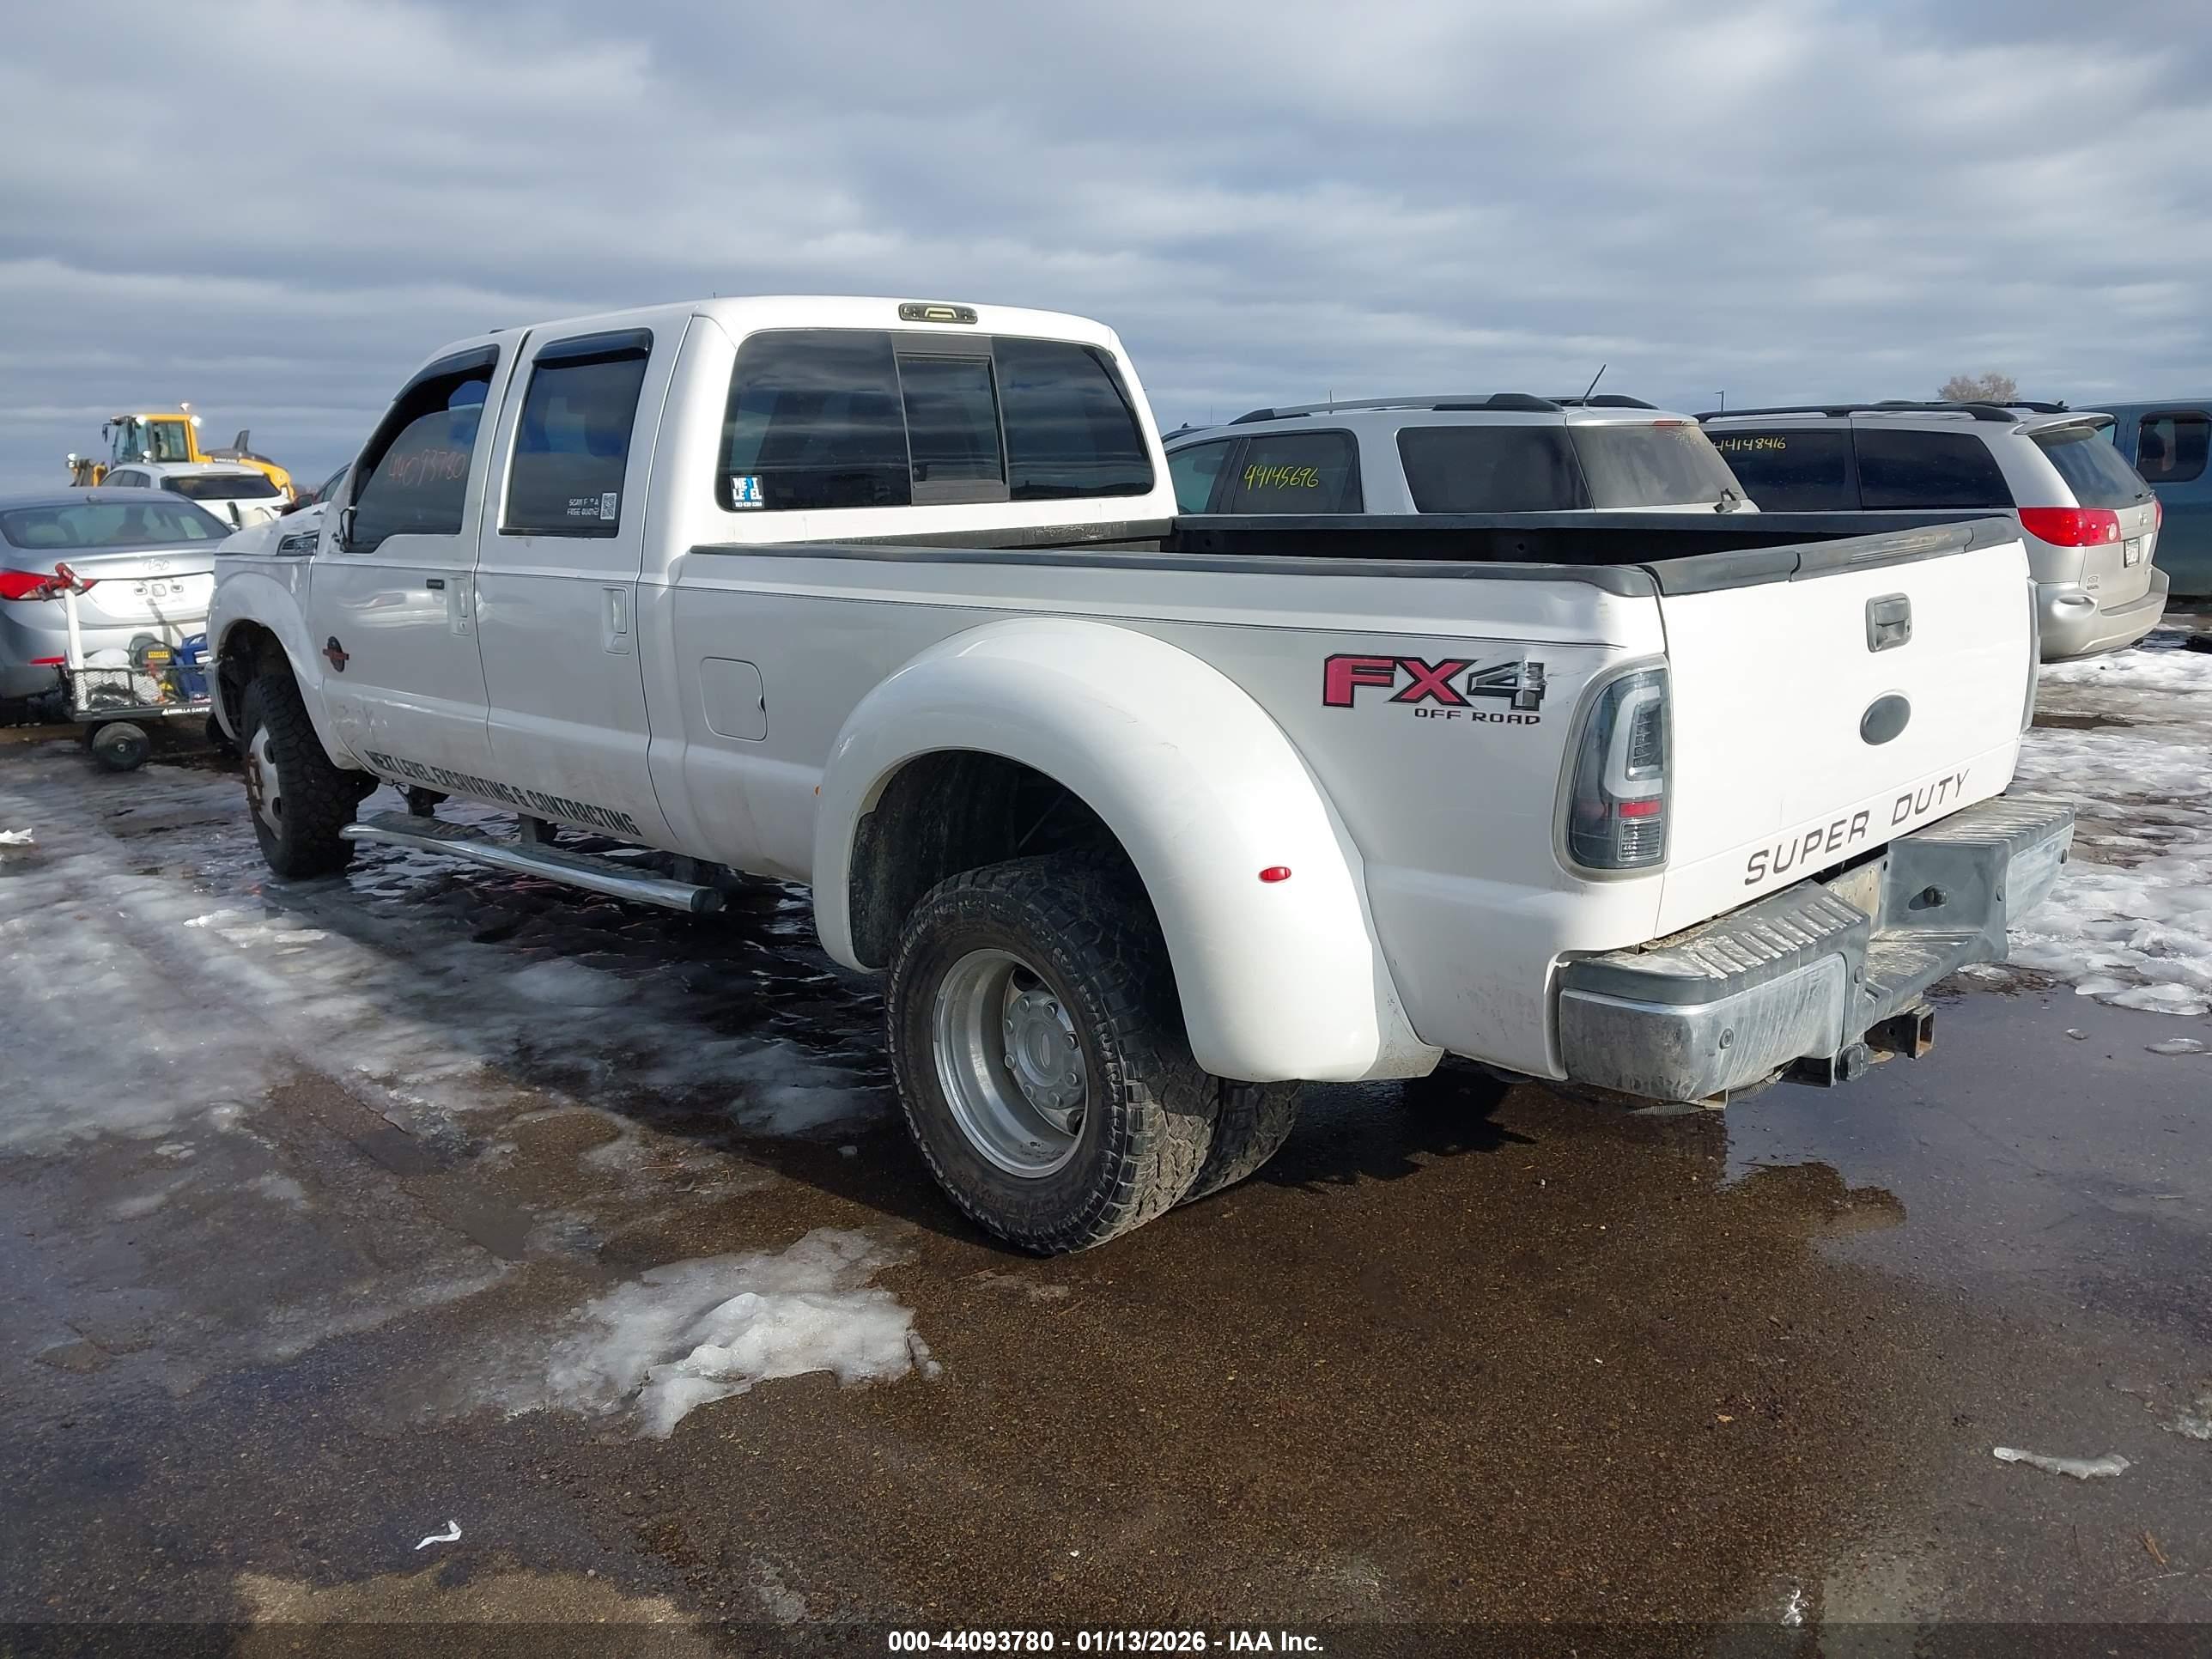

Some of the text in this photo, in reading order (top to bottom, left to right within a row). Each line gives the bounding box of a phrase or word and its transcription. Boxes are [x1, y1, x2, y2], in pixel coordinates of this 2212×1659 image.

[1322, 653, 1547, 711] FX4
[1413, 708, 1541, 725] OFF ROAD
[526, 789, 642, 837] CONTRACTING
[1744, 769, 1970, 886] SUPER DUTY
